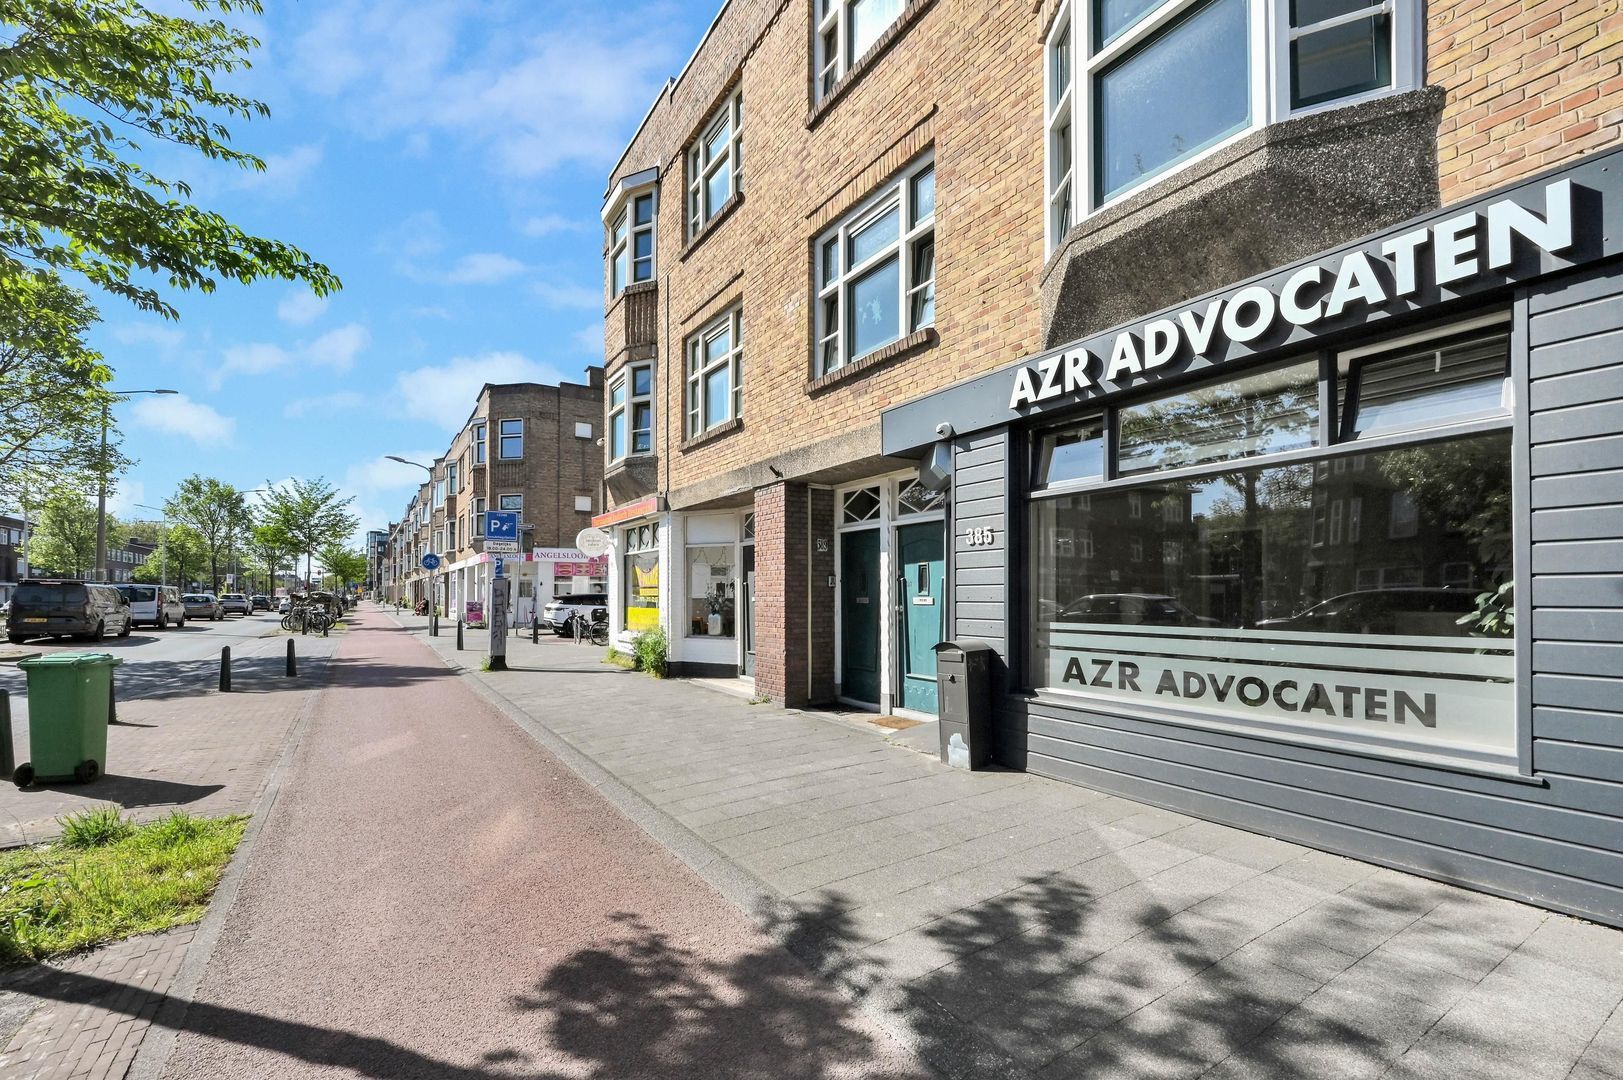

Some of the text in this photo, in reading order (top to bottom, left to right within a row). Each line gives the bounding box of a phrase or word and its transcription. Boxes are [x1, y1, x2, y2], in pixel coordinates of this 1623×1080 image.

[1008, 177, 1574, 409] AZR ADVOCATEN
[491, 519, 500, 532] P
[966, 526, 992, 545] 385
[1062, 656, 1437, 729] AZR ADVOCATEN
